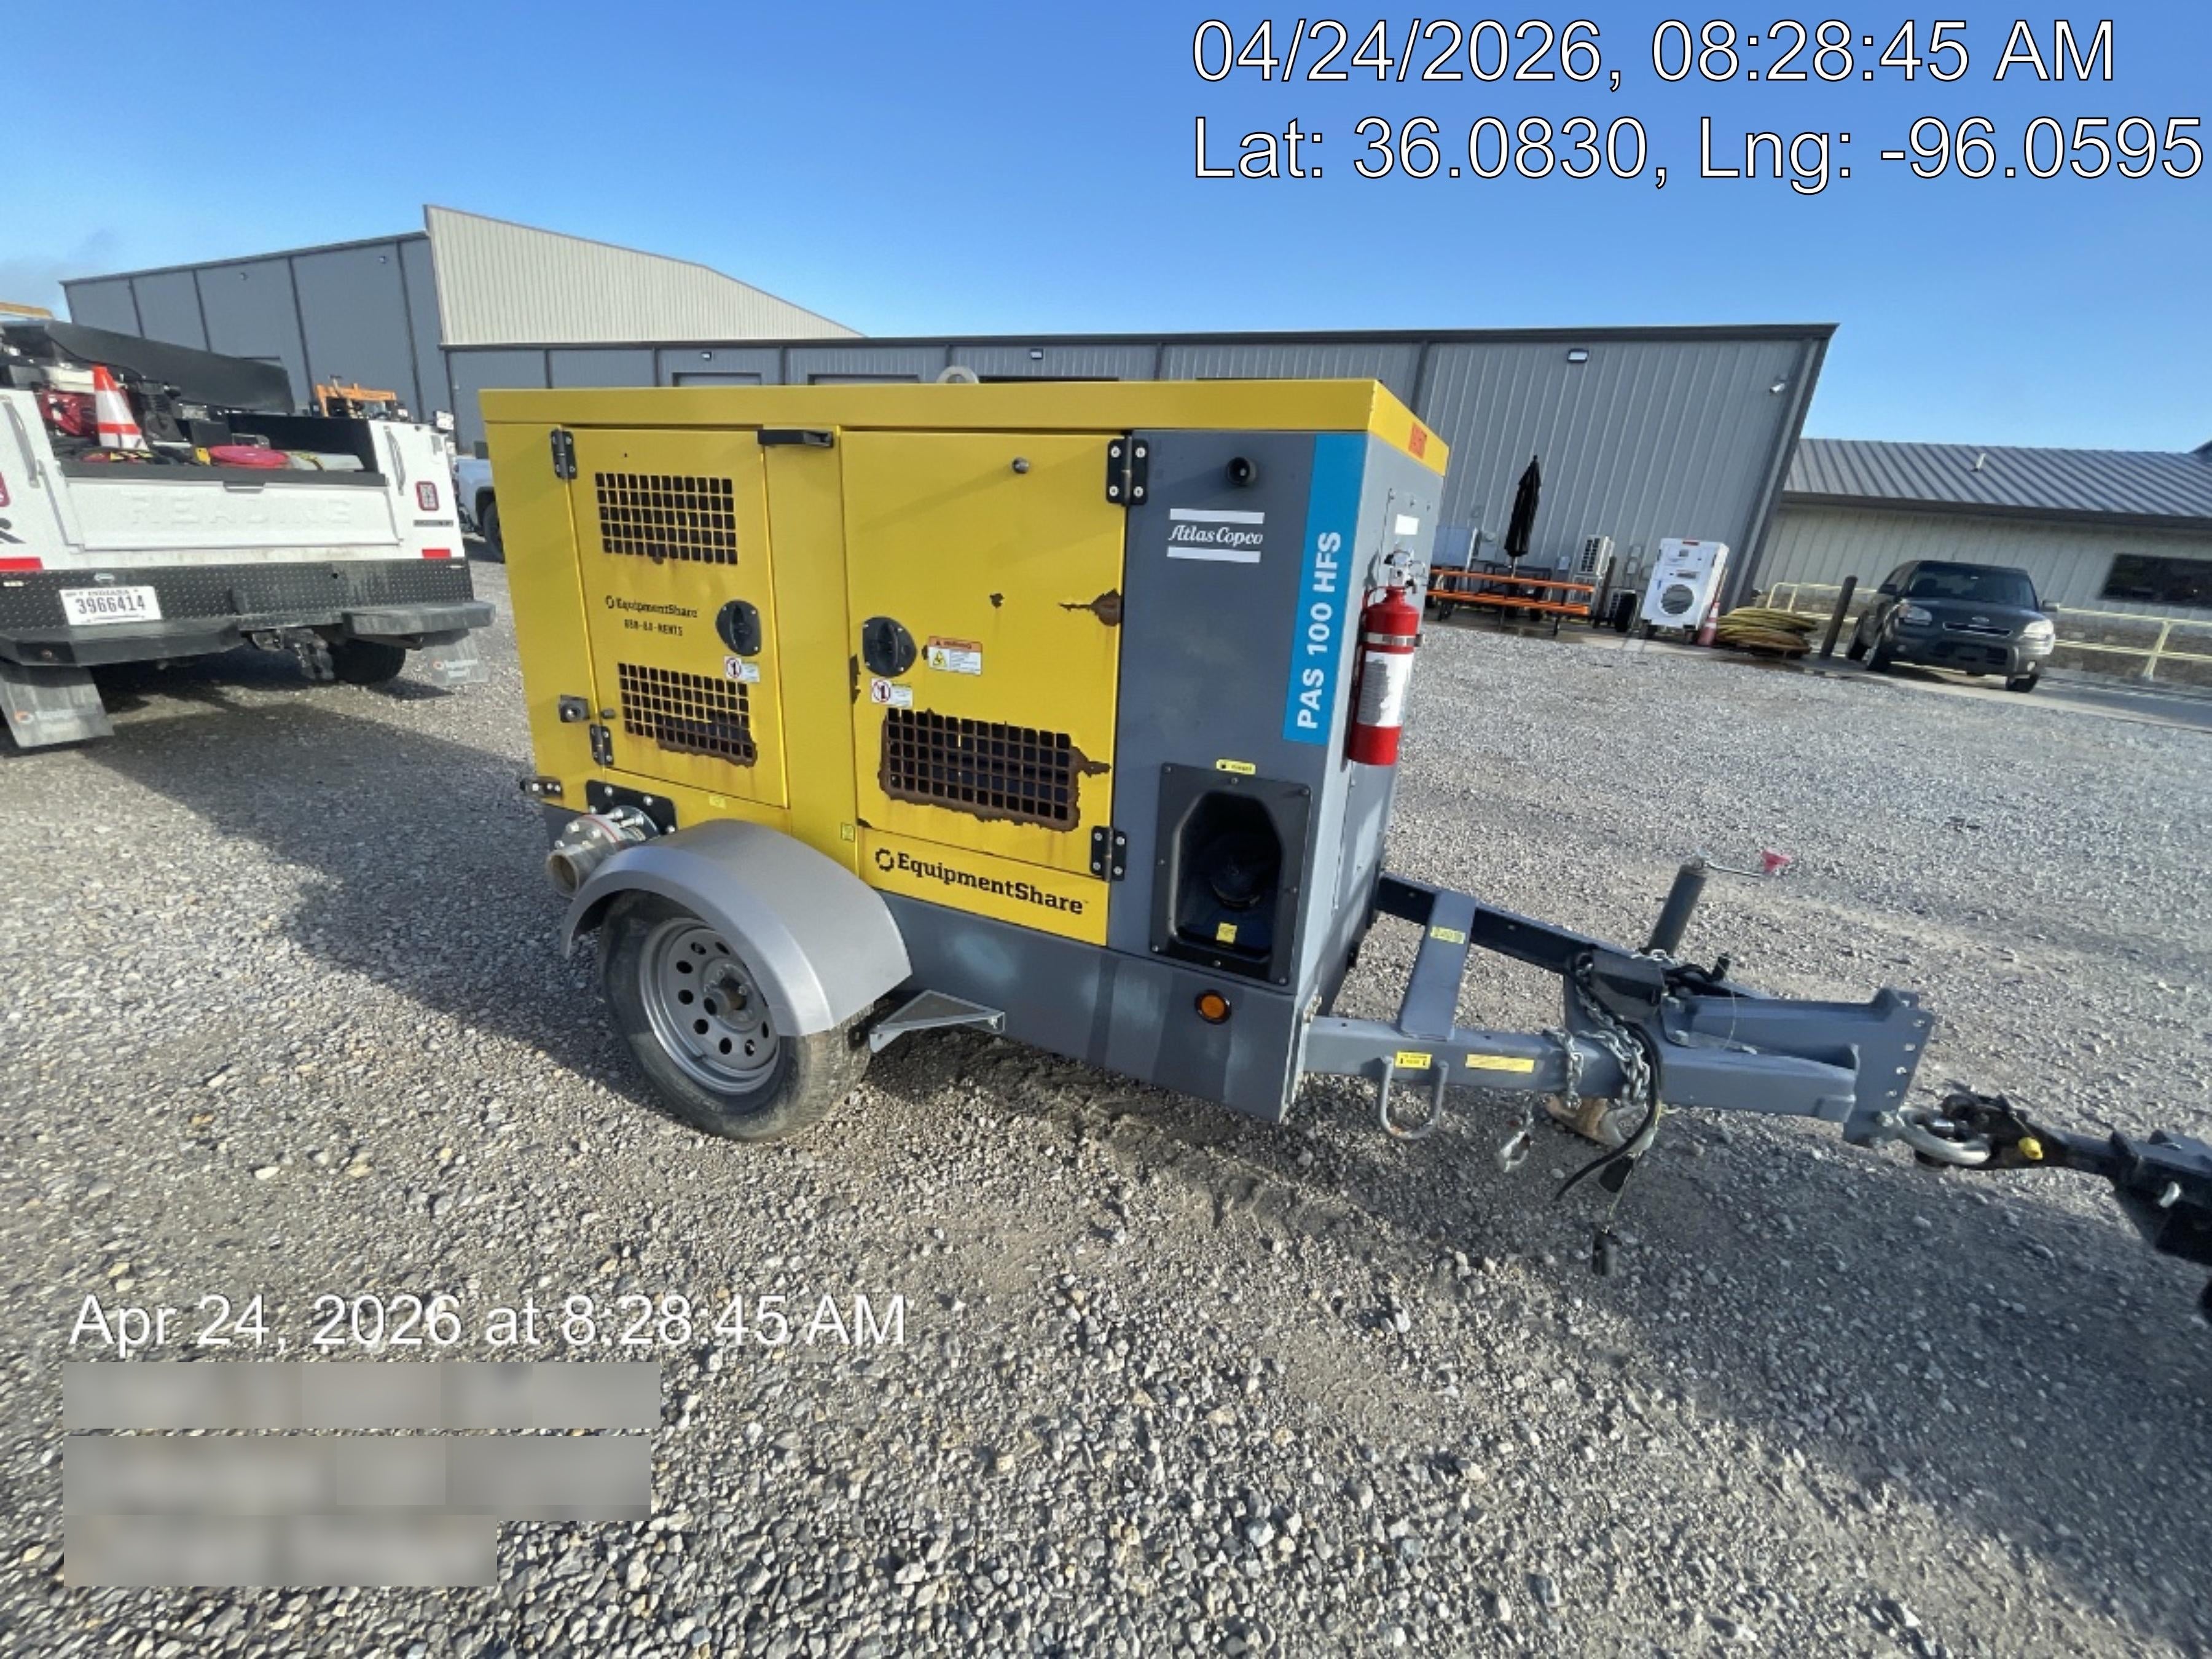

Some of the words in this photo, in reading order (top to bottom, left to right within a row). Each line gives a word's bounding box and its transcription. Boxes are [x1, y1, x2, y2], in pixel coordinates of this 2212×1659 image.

[1167, 525, 1215, 543] Atlas
[1215, 526, 1264, 548] Copco
[1312, 531, 1341, 593] HFS
[75, 594, 146, 614] 3966414
[1307, 602, 1333, 656] 100
[1296, 668, 1325, 729] PAS
[897, 852, 1083, 915] EquipmentShare
